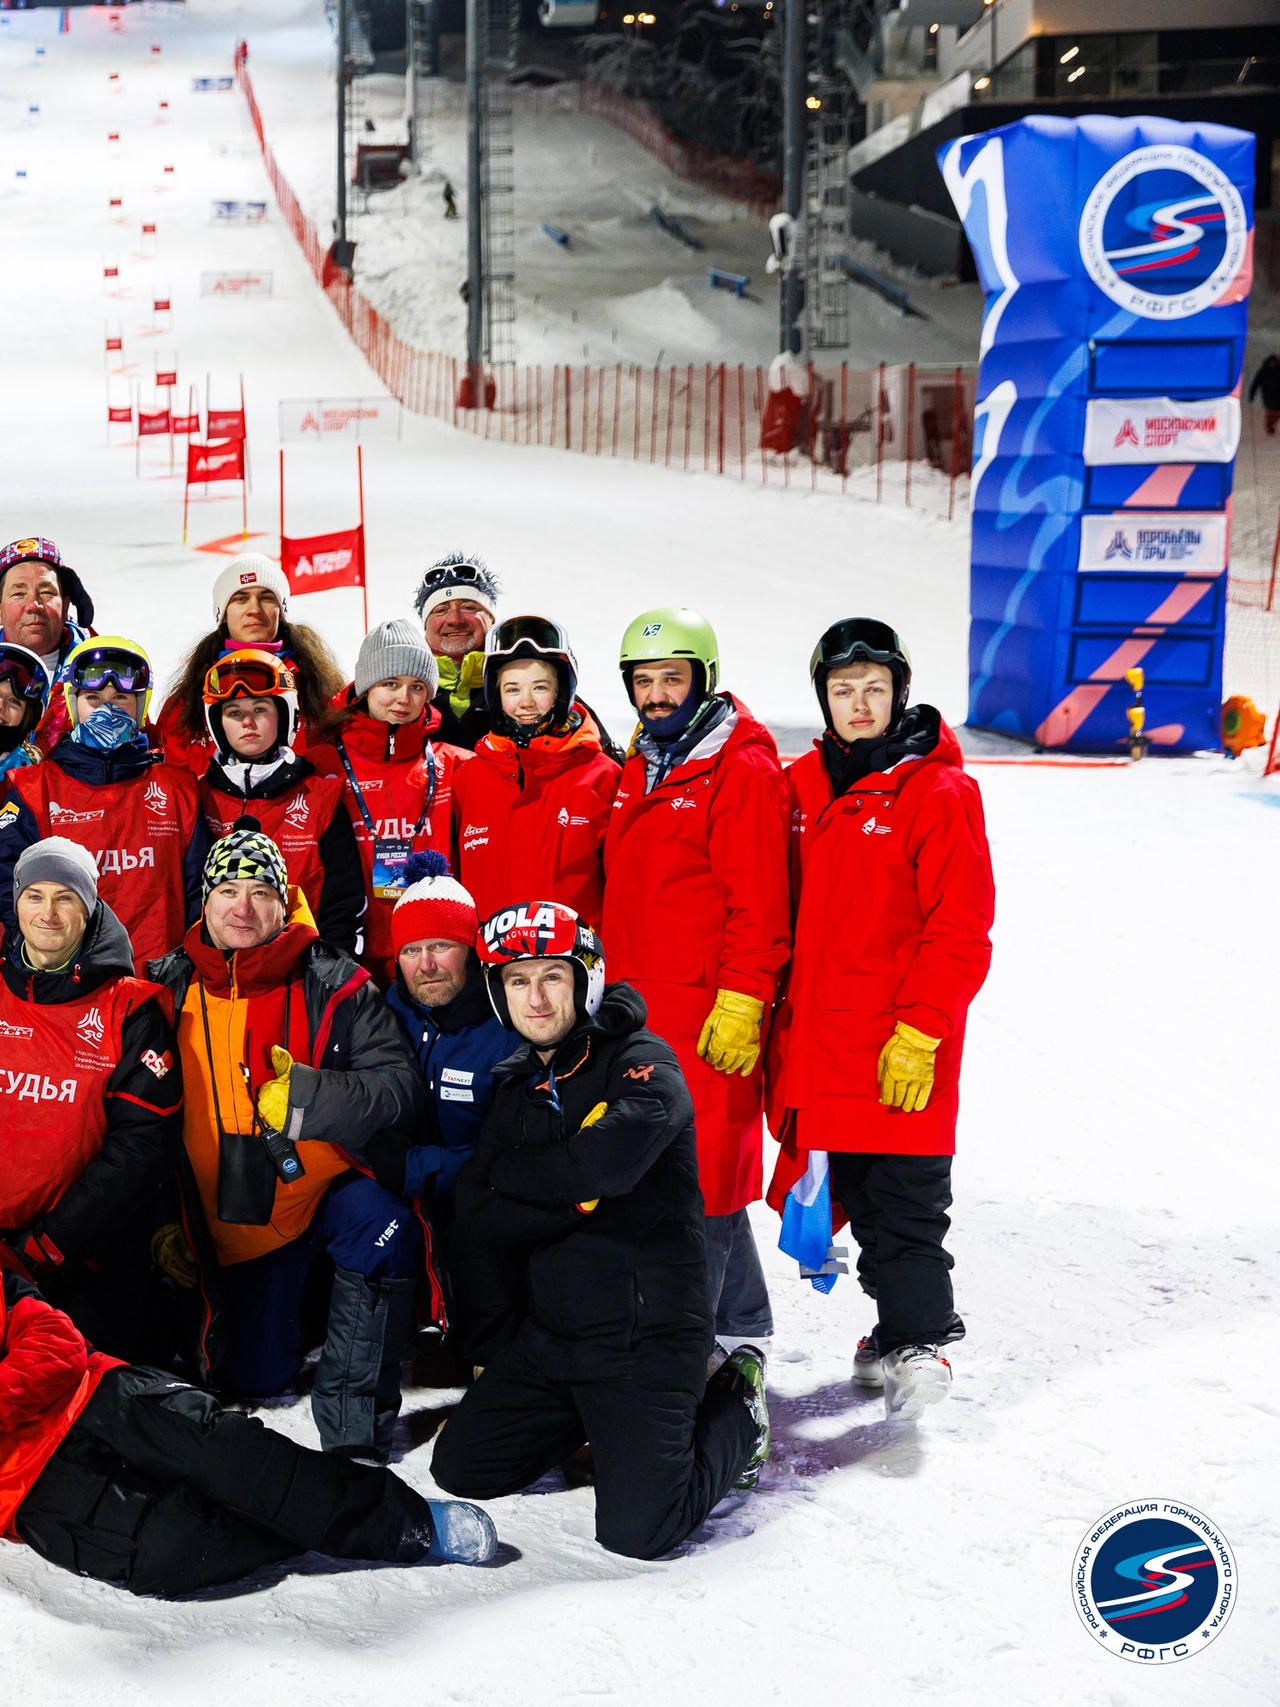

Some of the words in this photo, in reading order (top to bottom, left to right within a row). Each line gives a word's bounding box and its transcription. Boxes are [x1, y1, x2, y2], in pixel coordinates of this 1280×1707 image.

[1129, 295, 1197, 313] РФГС
[1144, 432, 1178, 448] СПОРТ
[93, 846, 155, 876] УДЬЯ
[383, 889, 402, 898] СУДЬЯ
[484, 907, 555, 944] VOLA
[500, 929, 537, 946] RACING
